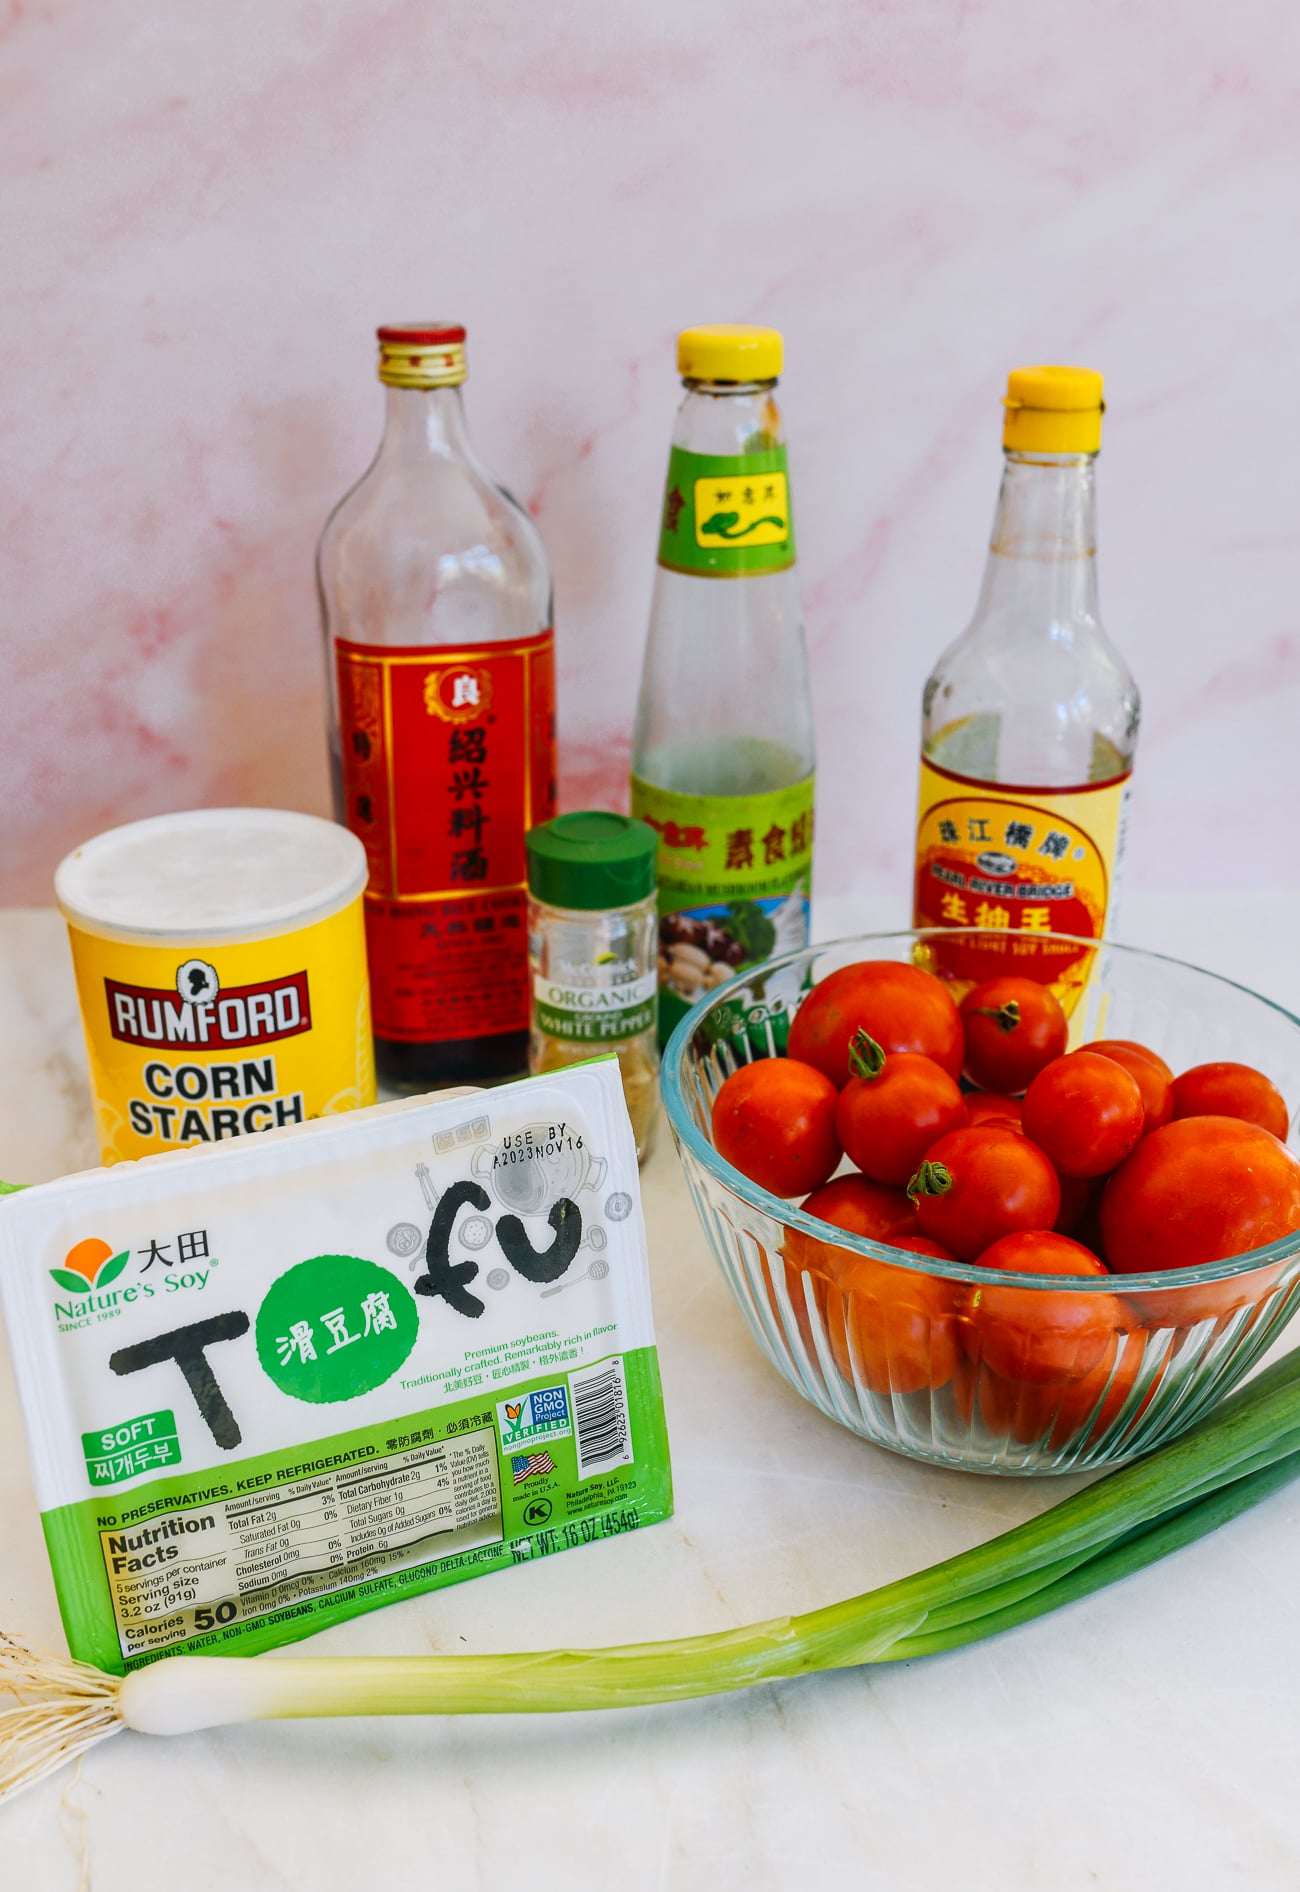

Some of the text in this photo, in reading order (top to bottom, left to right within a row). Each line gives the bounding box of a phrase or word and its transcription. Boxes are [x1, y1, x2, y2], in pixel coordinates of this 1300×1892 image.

[932, 864, 1074, 900] PEARL RIVER BRIDGE
[548, 982, 644, 1008] ORGANIC
[540, 1014, 594, 1037] WHITE
[143, 1056, 277, 1099] CORN
[128, 1093, 304, 1144] STARCH
[504, 1123, 567, 1150] USE BY
[137, 1229, 210, 1273] 大田
[54, 1282, 155, 1322] Nature's
[58, 1308, 121, 1332] SINCE 1989
[276, 1291, 398, 1366] 滑豆腐
[464, 1329, 560, 1360] Premium soybeans.
[400, 1367, 463, 1390] Traditionally
[464, 1356, 503, 1374] crafted.
[505, 1340, 563, 1362] Remarkably
[564, 1335, 583, 1346] rich
[584, 1333, 592, 1341] in
[533, 1390, 563, 1404] NON
[534, 1400, 565, 1414] GMO
[535, 1411, 566, 1421] Project
[101, 1418, 157, 1451] SOFT
[503, 1428, 571, 1452] nongmoproject.org
[505, 1421, 567, 1442] VERIFIED
[94, 1442, 174, 1481] 찌개두부
[435, 1462, 448, 1472] 1%
[450, 1459, 465, 1468] Value
[462, 1459, 490, 1473] how much
[98, 1516, 117, 1527] NO
[122, 1485, 233, 1523] PRESERVATIVES.
[237, 1474, 272, 1491] KEEP
[276, 1446, 379, 1480] REFRIGERATED.
[339, 1471, 421, 1501] Total Carbohydrate 2g
[437, 1477, 450, 1488] 4%
[454, 1481, 473, 1492] serving
[457, 1473, 478, 1483] nutrient
[523, 1477, 549, 1490] Proudly
[607, 1488, 616, 1496] PA
[616, 1481, 637, 1494] 19123
[322, 1496, 336, 1506] 3%
[347, 1491, 404, 1515] Dietary Fiber 1g
[454, 1487, 483, 1500] contributes
[455, 1499, 467, 1507] daily
[512, 1492, 530, 1502] made
[539, 1482, 561, 1495] U.S.A.
[566, 1488, 589, 1499] Nature
[324, 1511, 338, 1520] 0%
[456, 1504, 476, 1515] calories
[478, 1503, 497, 1515] general
[567, 1493, 628, 1516] www.naturesoy.com
[229, 1511, 276, 1531] Total Fat 2g
[350, 1506, 406, 1529] Total Sugars 0g
[350, 1505, 452, 1543] Includes of Added Sugars 0%
[108, 1515, 215, 1554] Nutrition
[240, 1520, 301, 1544] Saturated Fat 0g
[562, 1524, 579, 1546] 16
[581, 1515, 600, 1542] OZ
[244, 1538, 289, 1559] Trans Fat 0g
[328, 1541, 342, 1550] 0%
[347, 1539, 388, 1559] Protein 6g
[112, 1544, 179, 1575] Facts
[236, 1548, 300, 1577] Cholesterol 0mg
[330, 1554, 344, 1564] 0%
[117, 1556, 227, 1593] 5 servings per container
[238, 1568, 287, 1591] Sodium 0mg
[241, 1550, 404, 1607] Vitamin D 0mcg 0% Calcium 160mg 15%
[119, 1576, 199, 1605] Serving size
[242, 1566, 379, 1617] Iron 0mg Potassium 140mg 2%
[121, 1588, 197, 1618] 3.2 oz (91g)
[187, 1634, 221, 1652] WATER,
[223, 1620, 266, 1640] NON-GMO
[268, 1604, 316, 1626] SOYBEANS,
[318, 1589, 356, 1609] CALCIUM
[359, 1578, 397, 1596] SULFATE,
[399, 1564, 438, 1584] GLUCONO
[125, 1601, 237, 1640] Calories 50
[128, 1627, 186, 1652] per serving
